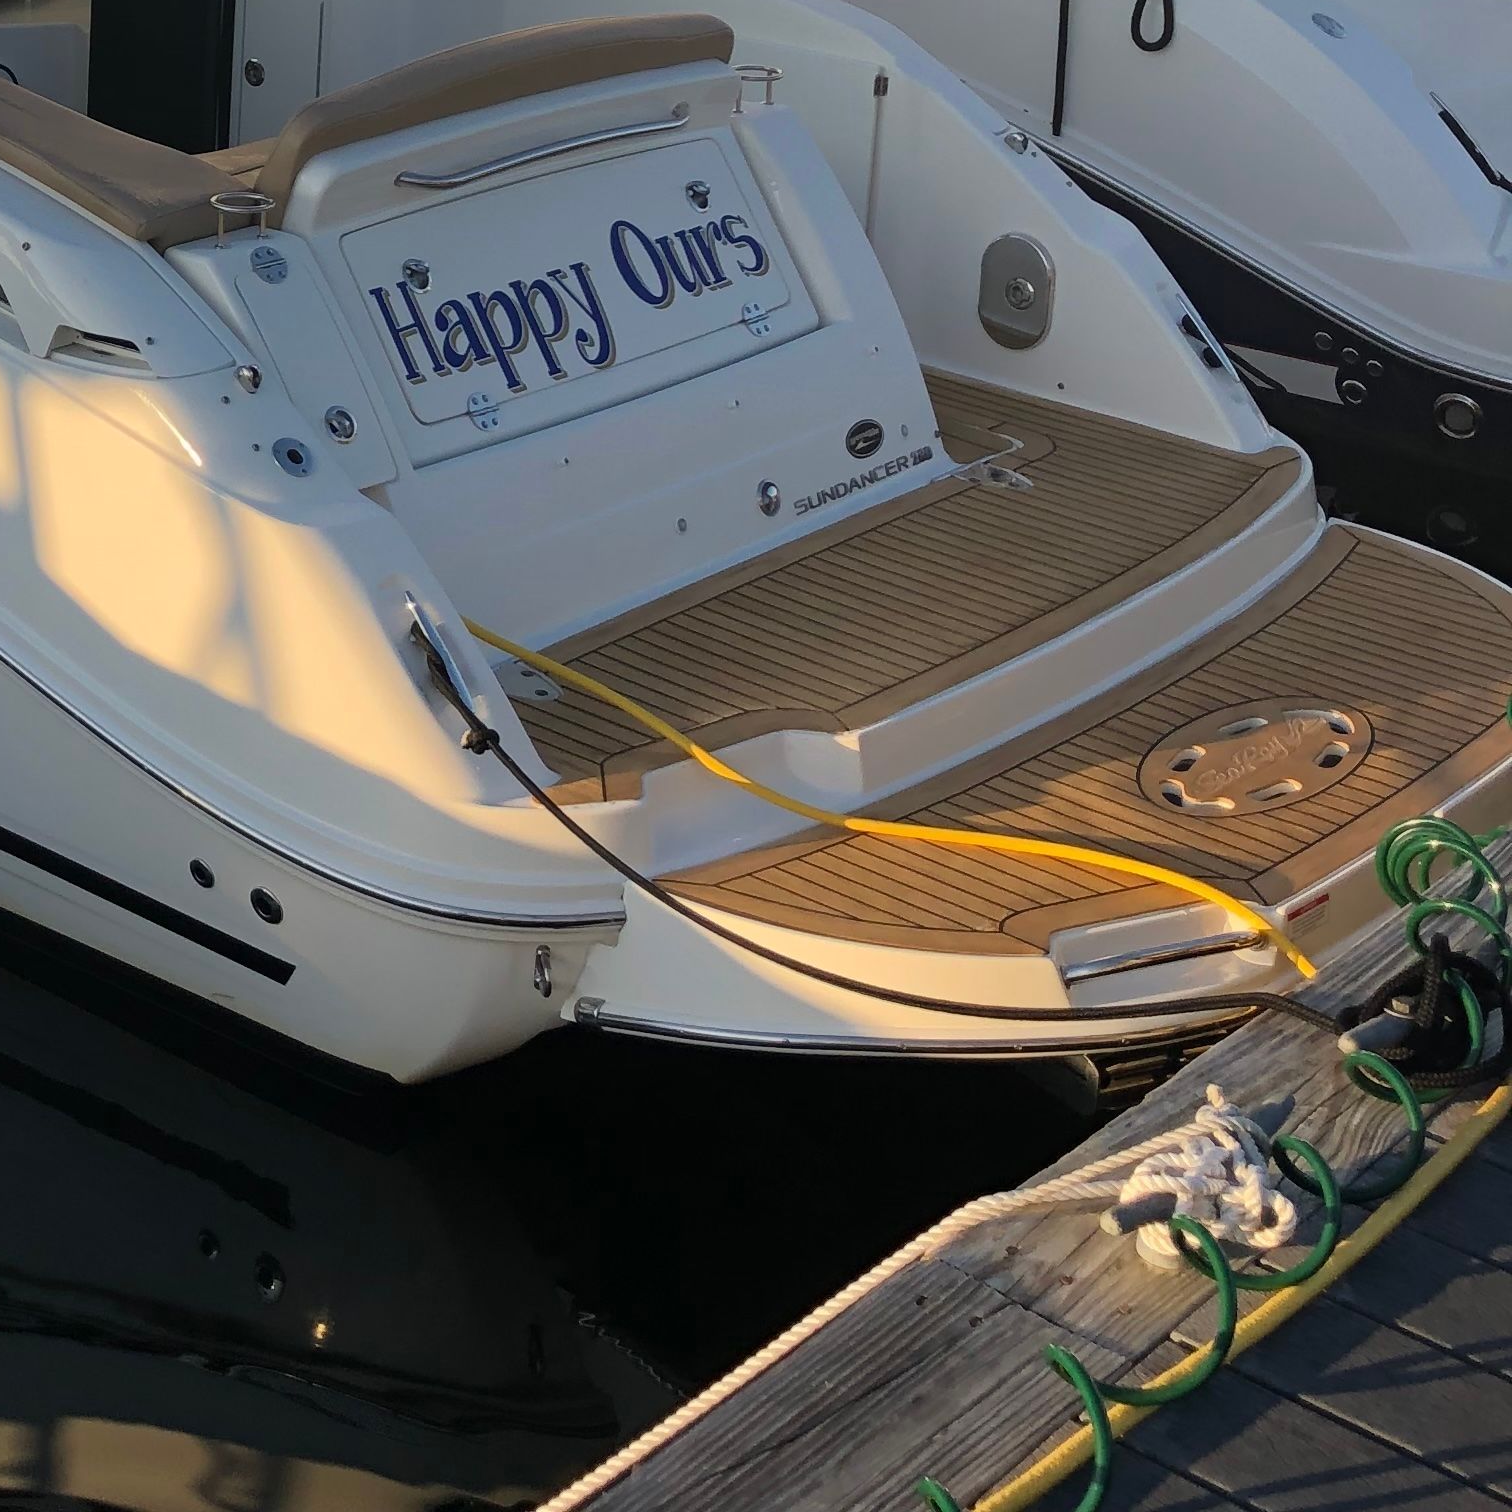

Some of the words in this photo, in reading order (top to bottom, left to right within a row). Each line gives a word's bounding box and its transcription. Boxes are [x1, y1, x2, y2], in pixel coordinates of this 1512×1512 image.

[368, 261, 617, 394] Happy
[609, 214, 770, 310] Ours
[793, 454, 910, 516] SUNDANCER
